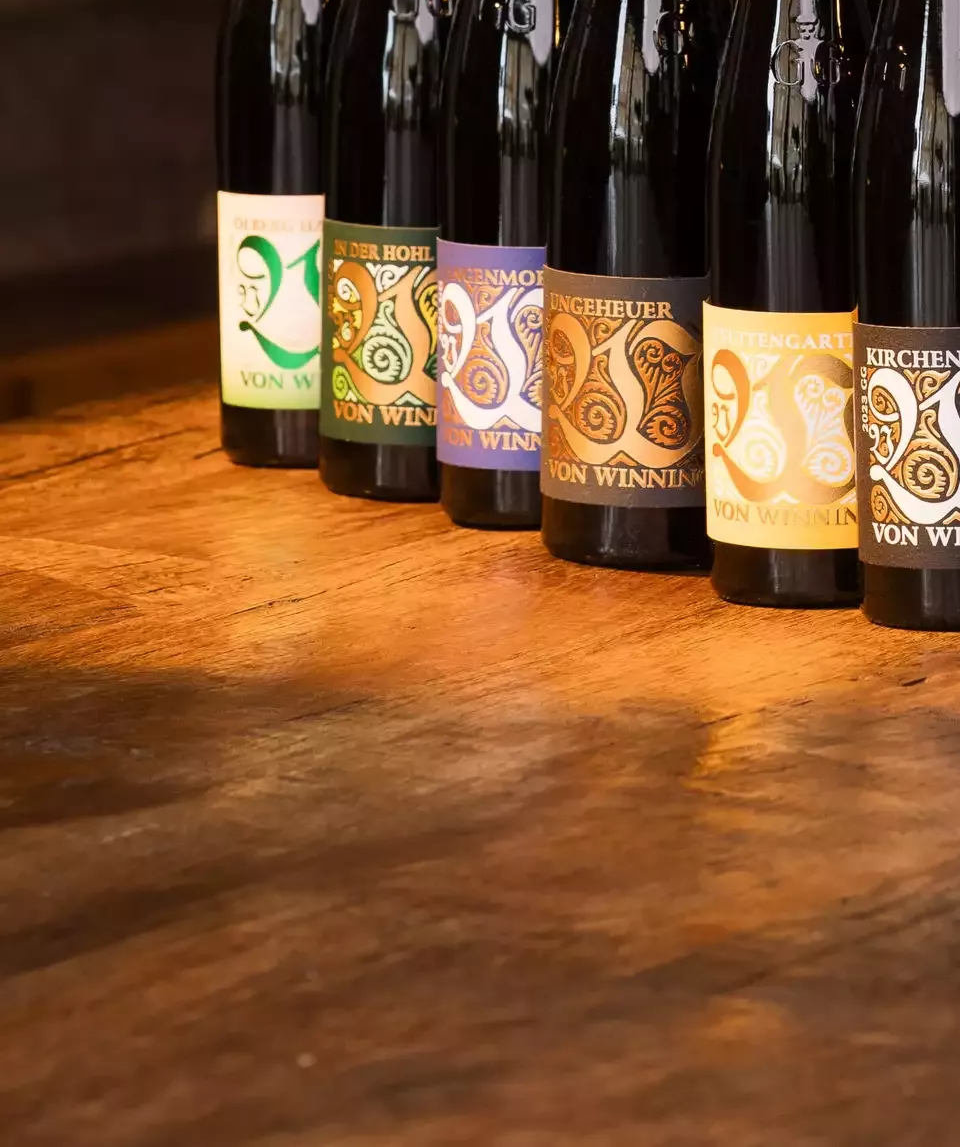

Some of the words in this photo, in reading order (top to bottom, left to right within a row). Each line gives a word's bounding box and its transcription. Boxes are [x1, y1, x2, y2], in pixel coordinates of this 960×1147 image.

[350, 242, 380, 261] DER
[550, 293, 674, 319] UNGEHEUER
[240, 370, 284, 390] VON
[860, 366, 868, 390] GG
[333, 399, 374, 424] VON
[861, 395, 869, 432] 2023
[548, 459, 588, 485] VON
[714, 498, 749, 523] VON
[872, 522, 919, 546] VON
